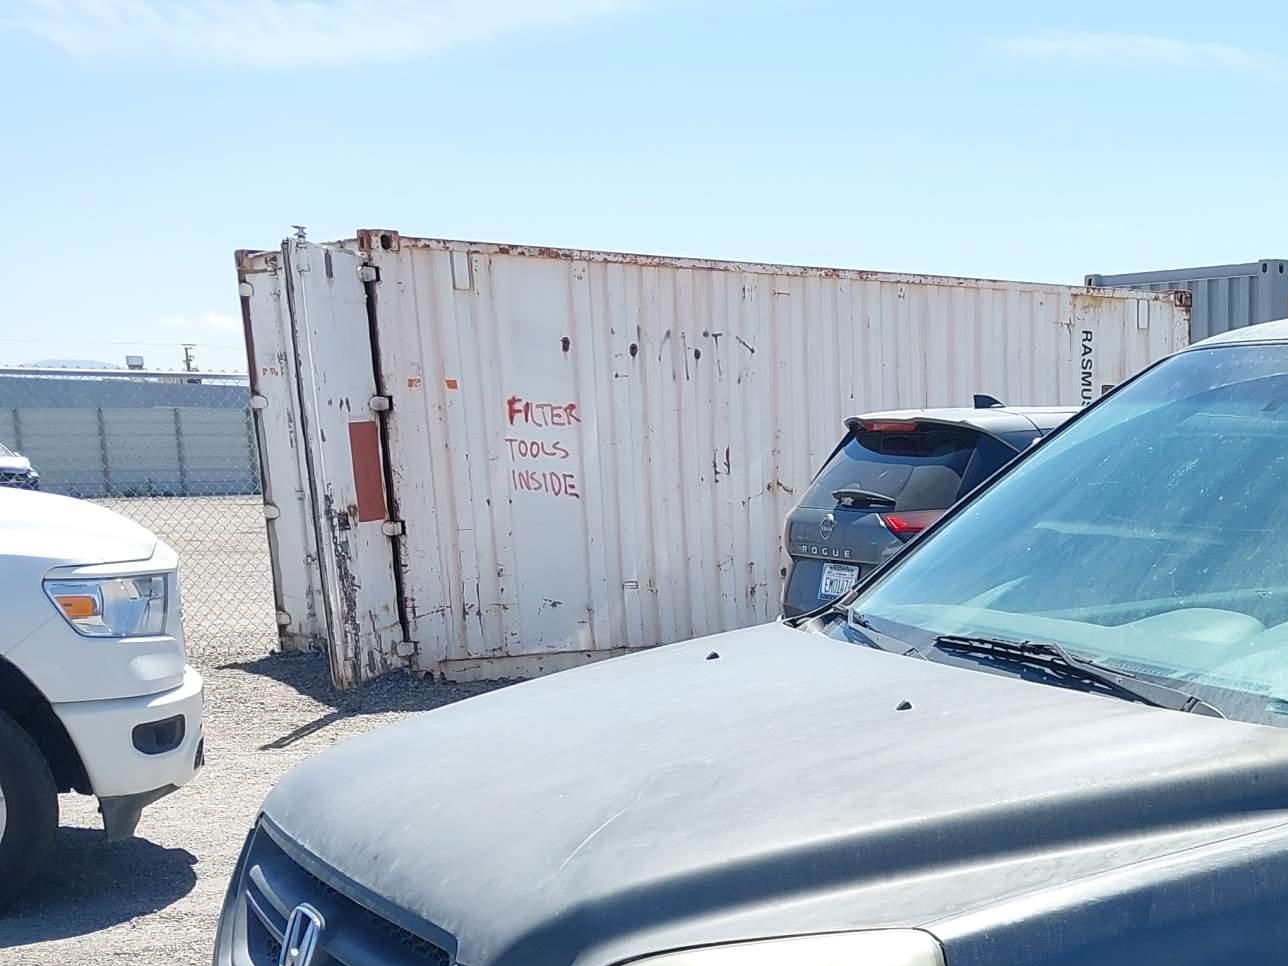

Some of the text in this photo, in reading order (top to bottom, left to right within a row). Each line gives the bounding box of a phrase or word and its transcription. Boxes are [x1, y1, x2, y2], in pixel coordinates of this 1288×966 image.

[507, 397, 582, 427] FILTER
[505, 438, 569, 462] TOOLS
[512, 470, 580, 499] INSIDE
[802, 545, 851, 558] ROGUE
